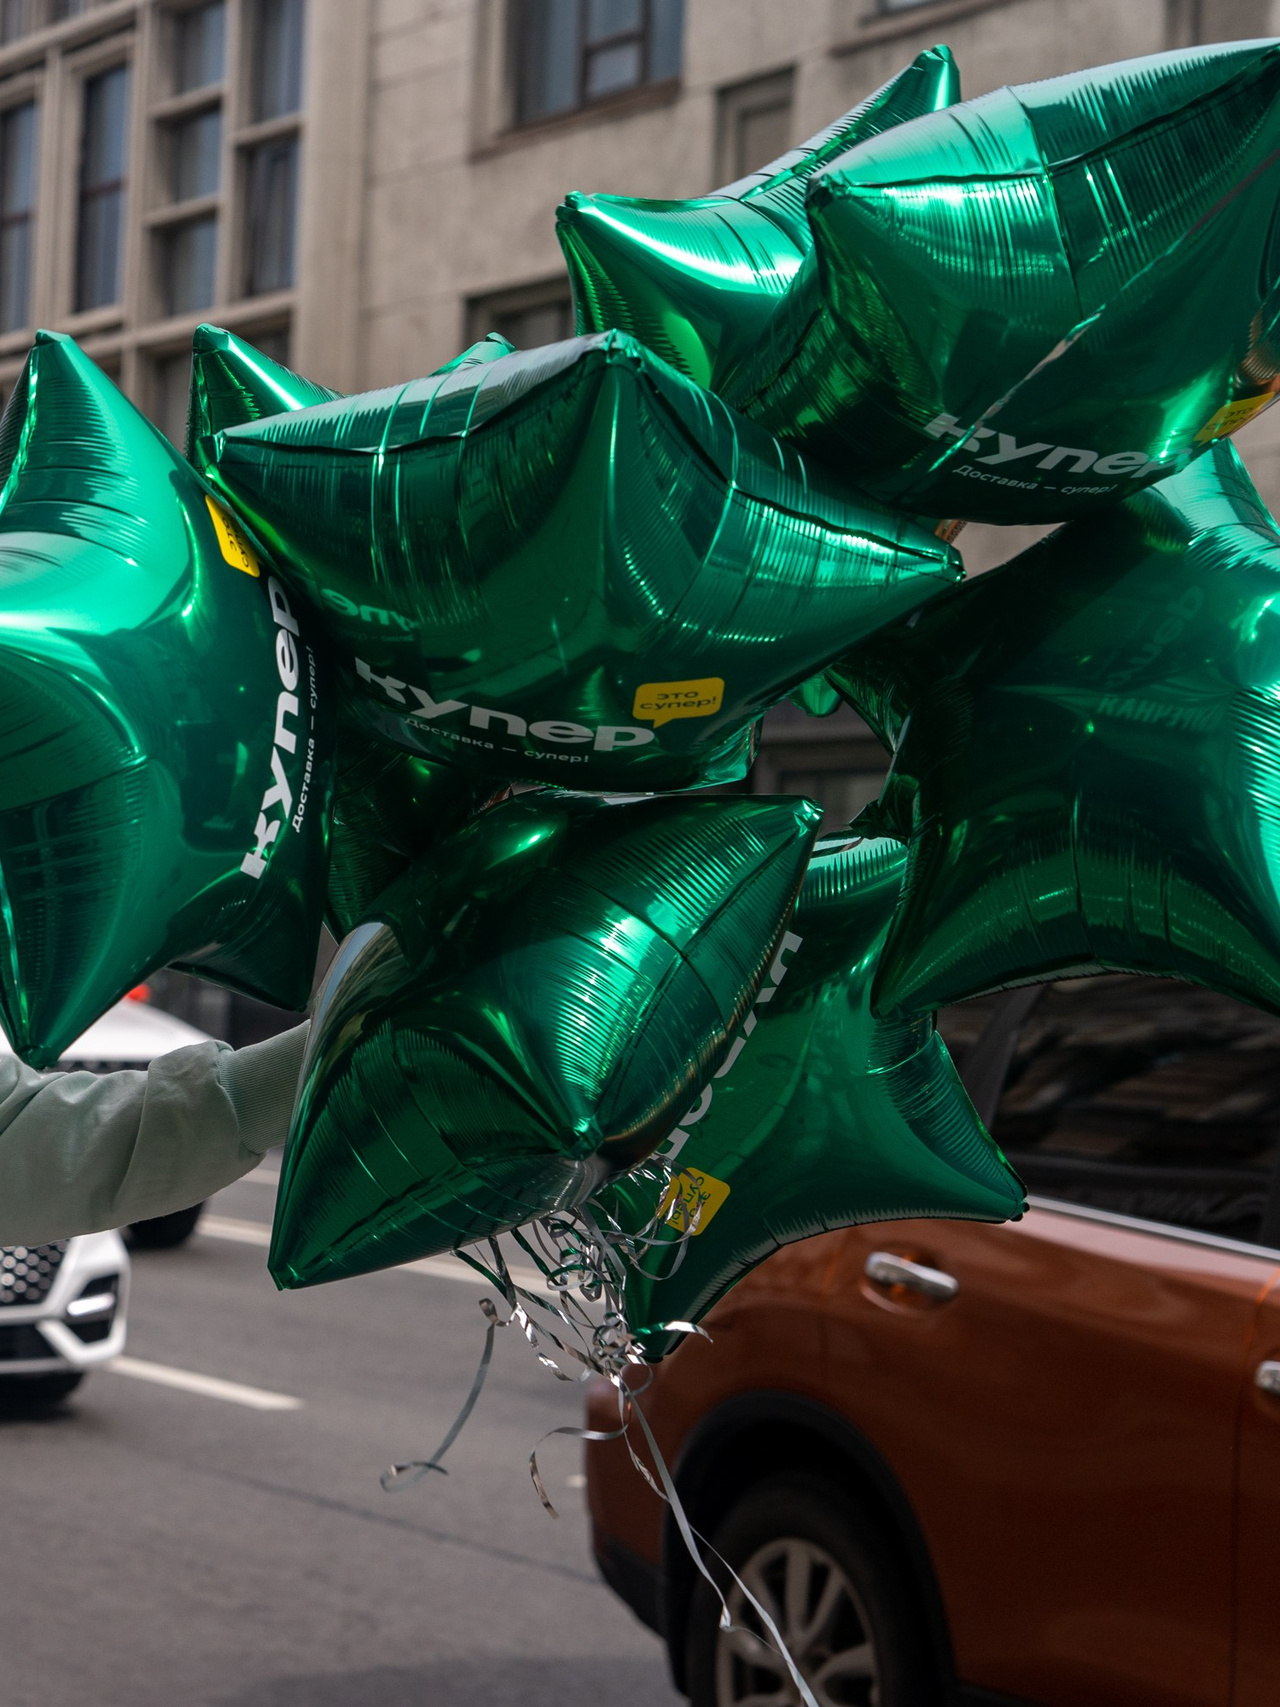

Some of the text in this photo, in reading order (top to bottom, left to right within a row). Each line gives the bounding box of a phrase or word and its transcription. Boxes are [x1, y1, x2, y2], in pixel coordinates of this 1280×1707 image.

[923, 412, 1193, 479] купер
[952, 464, 1039, 491] Доставка
[1061, 483, 1119, 496] супер!
[355, 657, 655, 751] купер
[639, 696, 717, 711] супер!
[656, 690, 699, 701] это
[240, 575, 300, 880] купер
[292, 738, 316, 833] Доставка
[305, 645, 319, 709] супер!
[404, 716, 494, 750] Доставка
[524, 749, 589, 764] супер!
